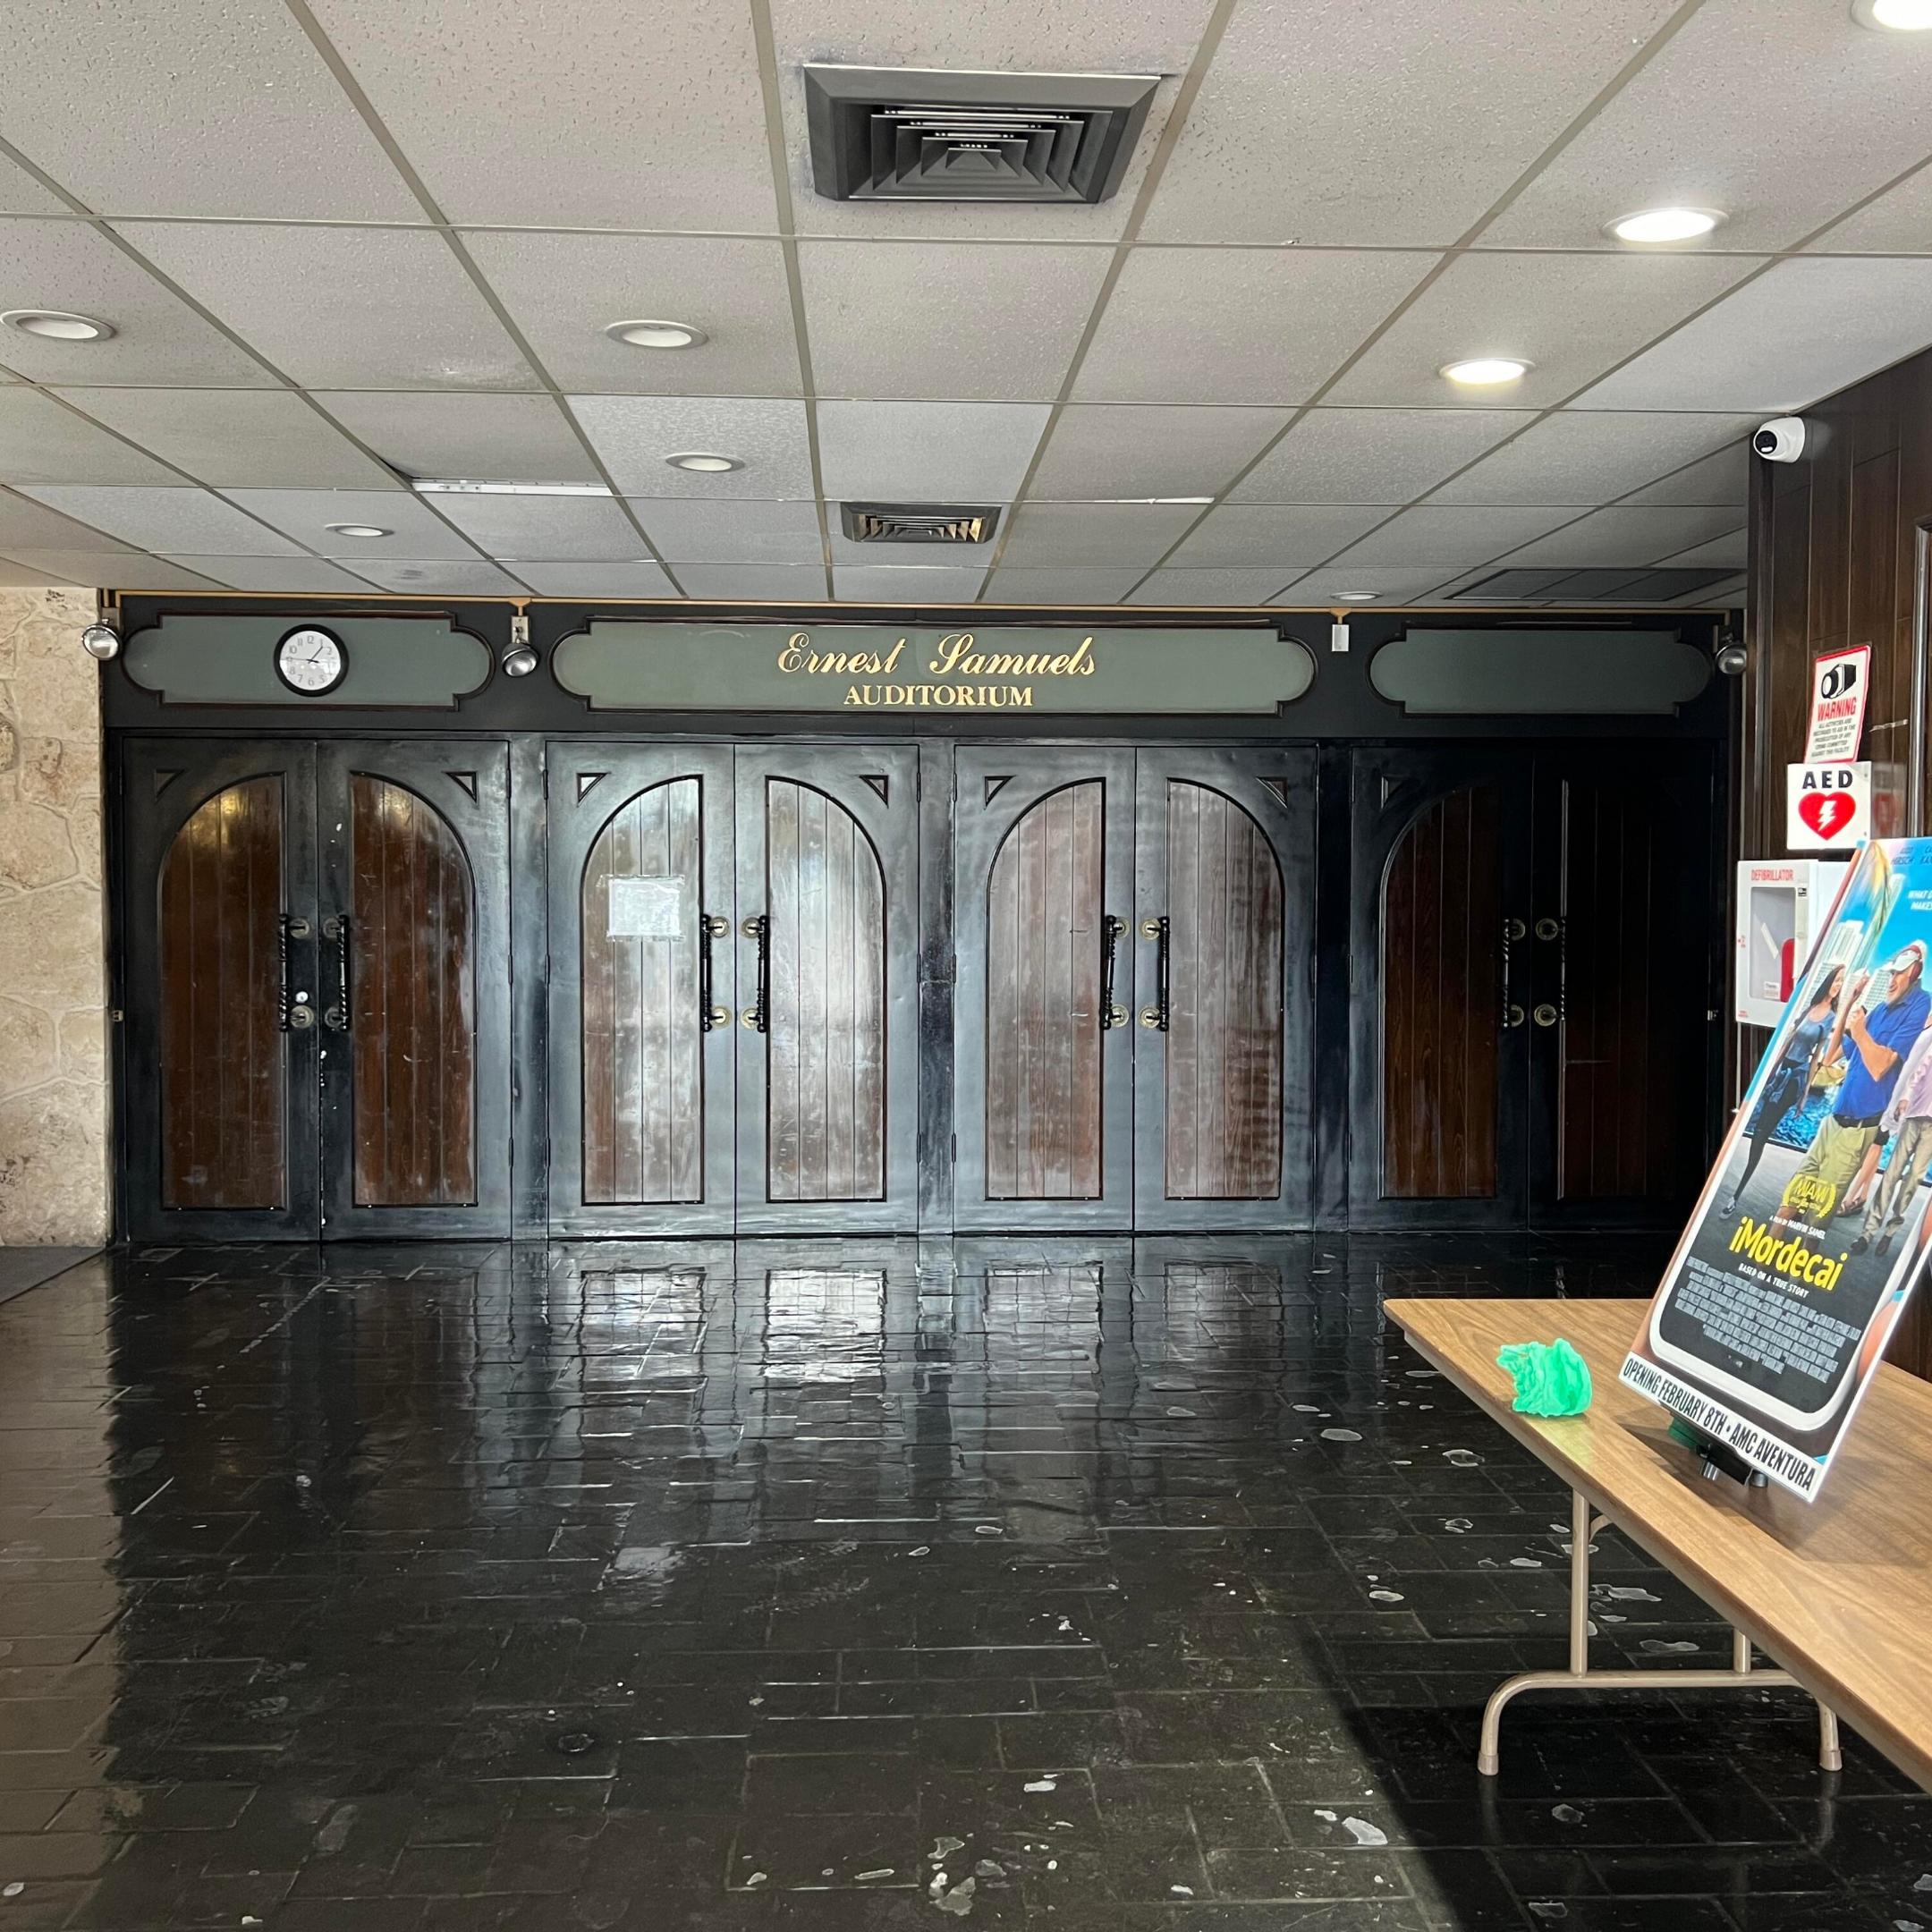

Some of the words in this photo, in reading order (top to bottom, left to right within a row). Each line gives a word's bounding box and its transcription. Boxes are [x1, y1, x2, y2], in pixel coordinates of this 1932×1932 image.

[777, 632, 906, 674] Ernest
[929, 633, 1096, 676] Samuels
[843, 685, 1033, 708] AUDITORIUM
[1818, 697, 1857, 722] WARNING
[1802, 770, 1853, 789] AED
[1751, 869, 1793, 881] DEFIBRILLATOR
[1728, 1216, 1848, 1291] iMordecai
[1738, 1263, 1757, 1276] BASED
[1757, 1270, 1767, 1280] ON
[1766, 1275, 1772, 1283] A
[1772, 1277, 1789, 1290] TRUE
[1787, 1284, 1809, 1298] STORY
[1623, 1358, 1662, 1394] OPENING
[1657, 1378, 1708, 1422] FEBRUARY
[1703, 1406, 1728, 1436] 8TH
[1728, 1423, 1758, 1454] AMC
[1753, 1437, 1817, 1491] AVENTURA
